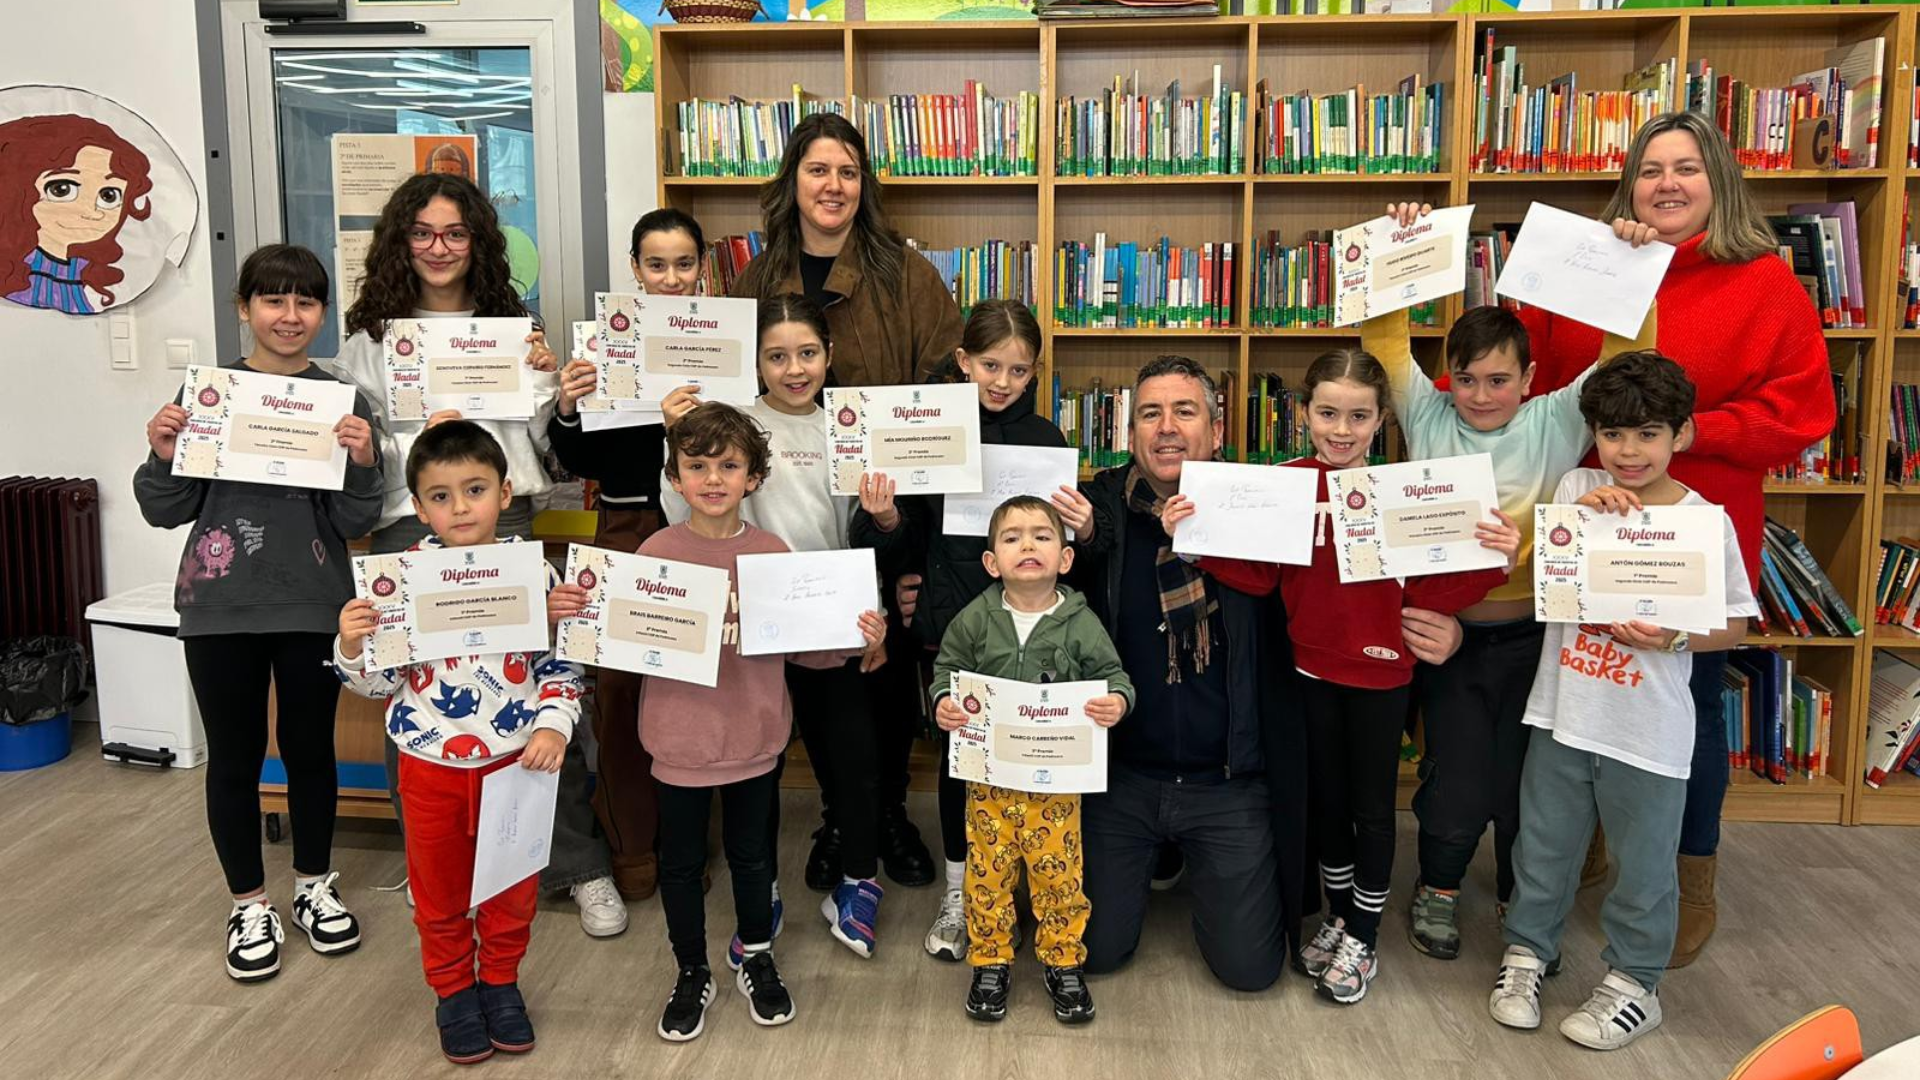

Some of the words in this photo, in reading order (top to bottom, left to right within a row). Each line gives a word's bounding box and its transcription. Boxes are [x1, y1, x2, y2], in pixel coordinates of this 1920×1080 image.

[1812, 119, 1830, 166] C
[1390, 223, 1433, 243] Diploma
[1343, 275, 1366, 289] Nadal
[668, 315, 718, 331] Diploma
[449, 337, 497, 351] Diploma
[605, 348, 636, 359] Nadal
[392, 372, 421, 382] Nadal
[261, 394, 314, 412] Diploma
[892, 406, 942, 421] Diploma
[188, 422, 222, 435] Nadal
[268, 424, 290, 434] GARCÍA
[291, 428, 320, 436] SALGADO
[834, 444, 863, 454] Nadal
[1402, 483, 1454, 499] Diploma
[1439, 510, 1466, 518] EXPÓSITO
[1345, 526, 1376, 538] Nadal
[1615, 528, 1676, 544] Diploma
[440, 567, 500, 584] Diploma
[1544, 564, 1578, 576] Nadal
[636, 578, 687, 598] Diploma
[466, 596, 490, 604] GARCÍA
[573, 608, 600, 620] adal
[674, 617, 696, 626] GARCÍA
[1574, 633, 1634, 669] Baby
[1560, 647, 1644, 688] Basket
[476, 666, 504, 693] SONIC
[1018, 705, 1069, 720] Diploma
[407, 726, 440, 750] SONIC
[958, 728, 986, 743] Nadal
